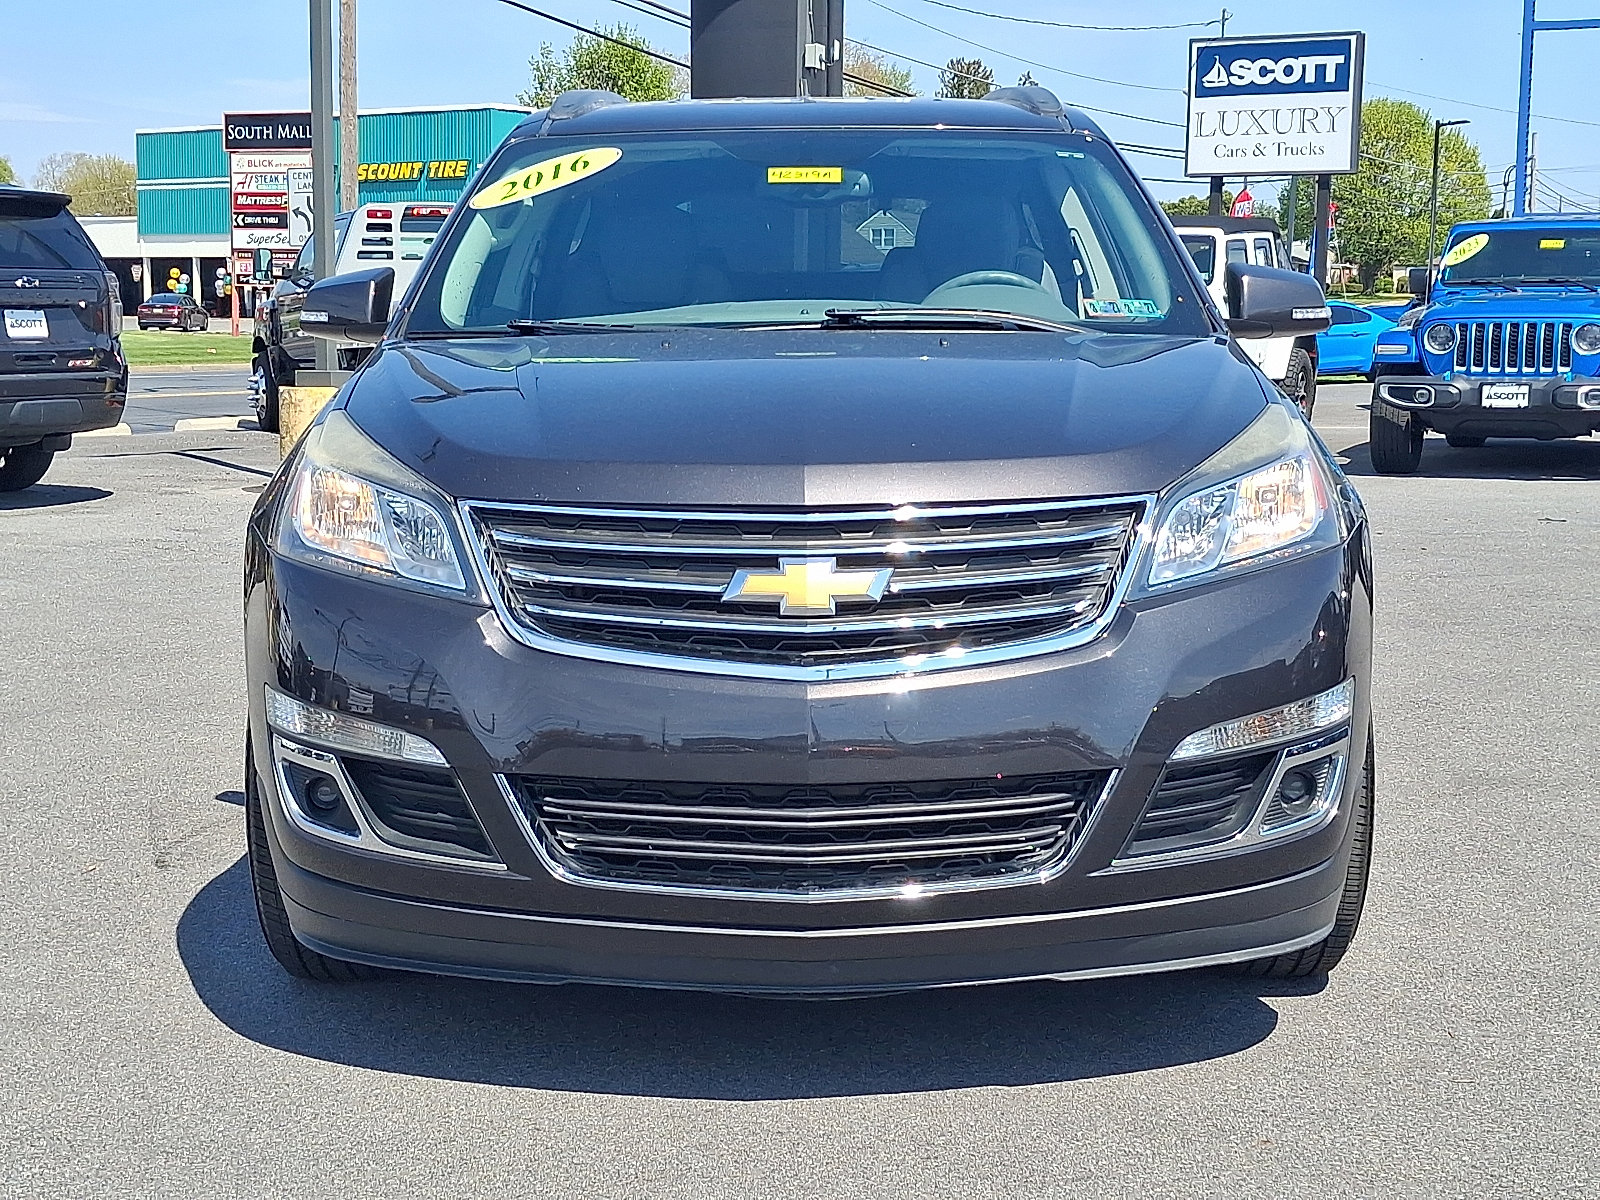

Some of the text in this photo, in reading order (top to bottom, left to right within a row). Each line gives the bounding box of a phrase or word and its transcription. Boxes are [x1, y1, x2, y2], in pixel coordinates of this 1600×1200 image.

[1229, 55, 1345, 86] SCOTT
[1194, 107, 1348, 138] LUXURY
[228, 124, 313, 140] SOUTH MALL
[1214, 141, 1325, 158] Cars & Trucks
[247, 159, 274, 168] BLICK
[428, 160, 468, 178] TIRE
[254, 174, 280, 184] STEAK
[500, 153, 590, 201] 2016
[1453, 237, 1480, 261] 2023
[1493, 392, 1528, 401] SCOTT
